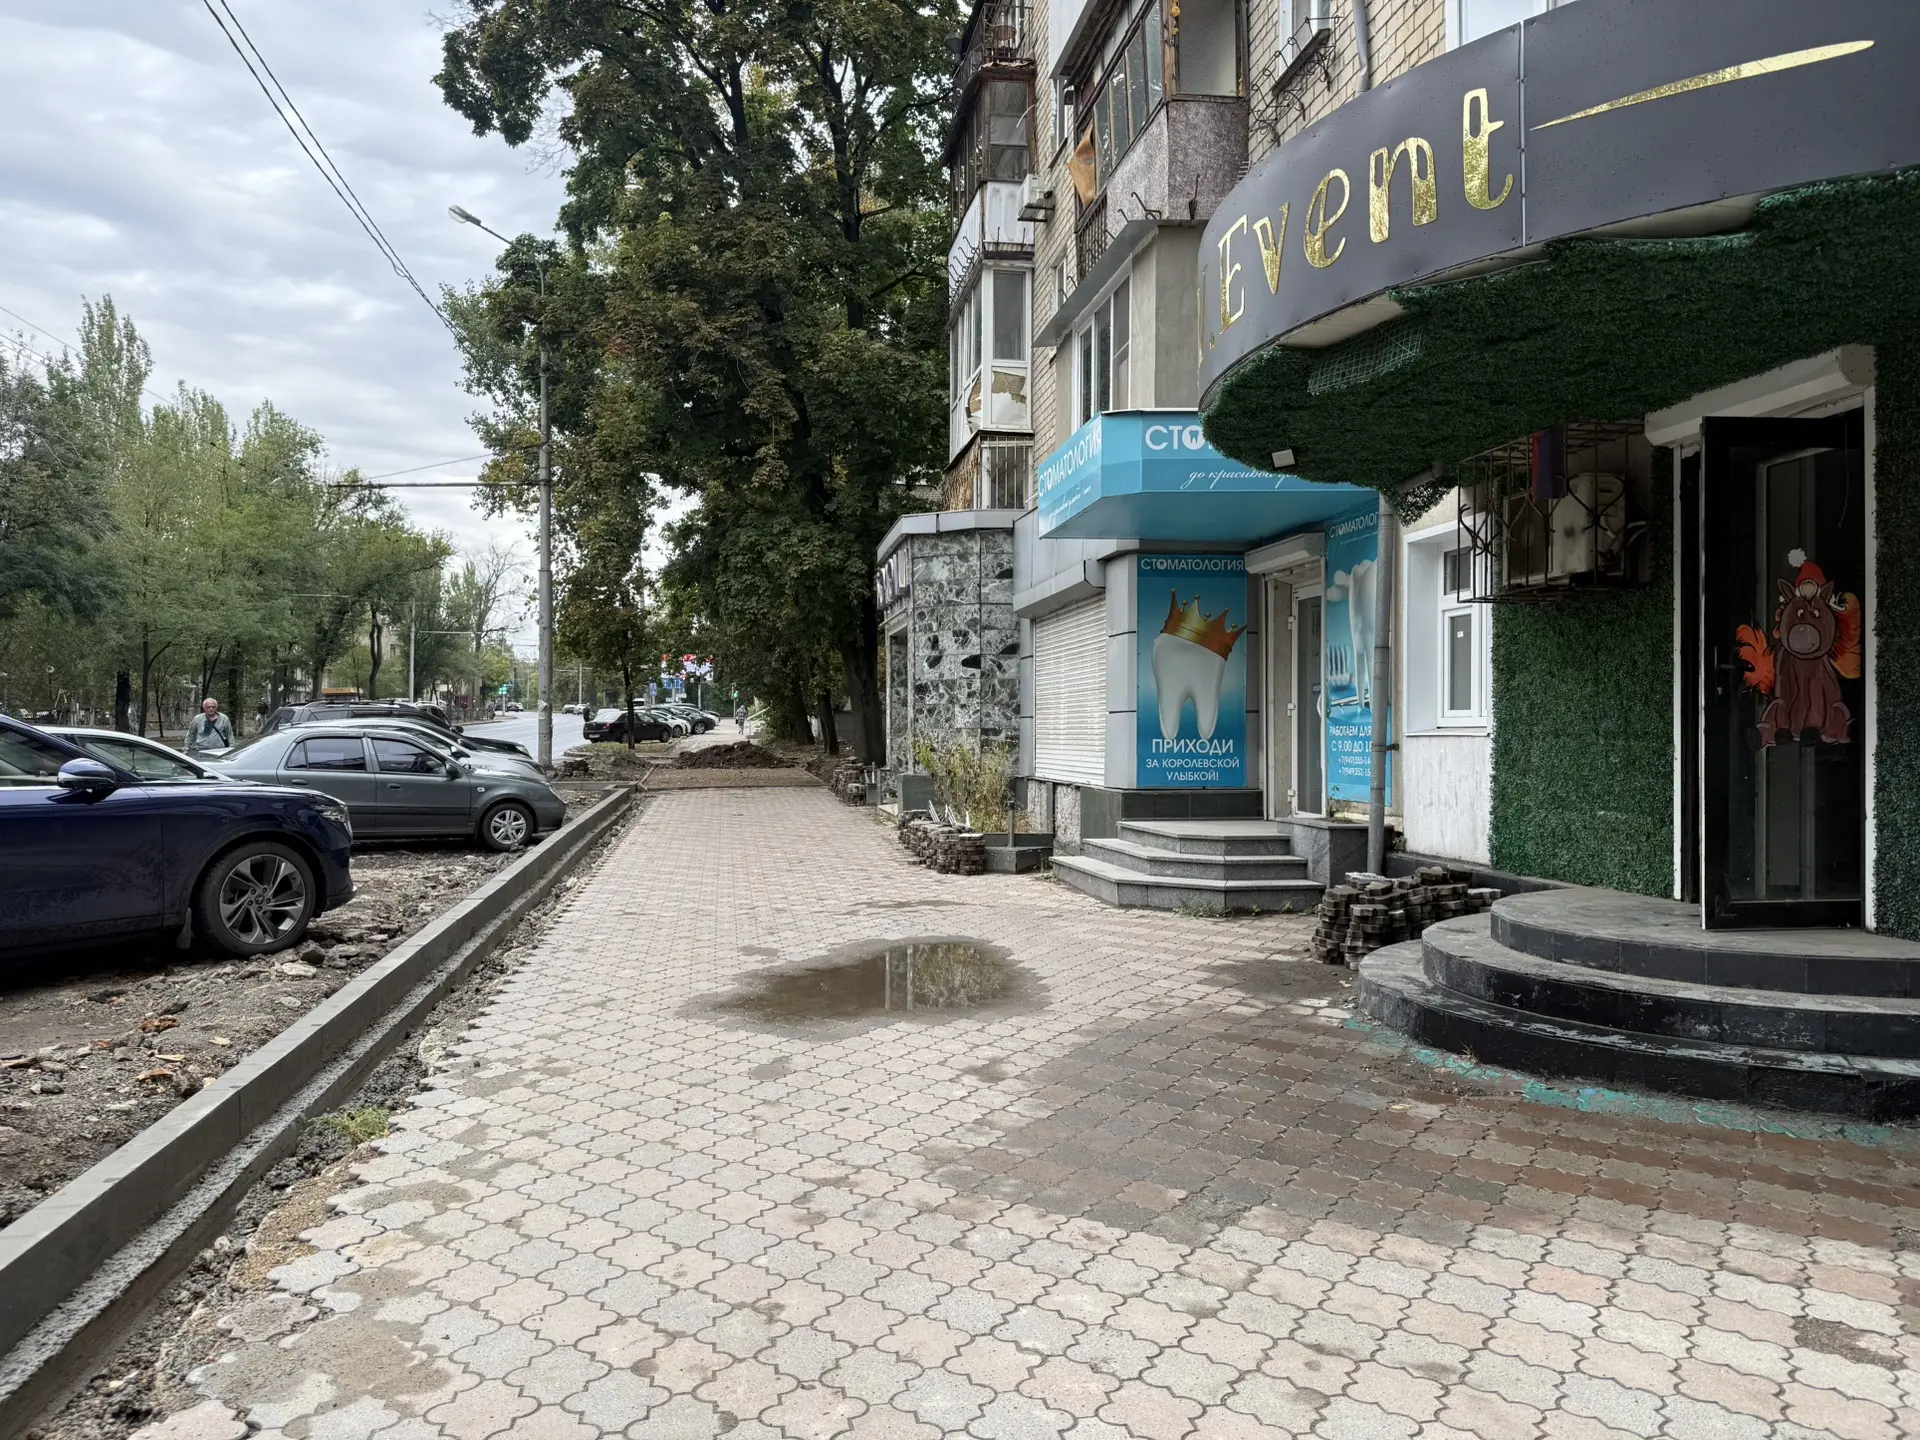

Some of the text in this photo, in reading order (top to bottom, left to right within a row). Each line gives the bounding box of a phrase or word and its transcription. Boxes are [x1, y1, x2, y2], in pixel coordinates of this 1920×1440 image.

[1218, 87, 1514, 335] Event
[1038, 428, 1102, 497] СТОМАТОЛОГИЯ
[1180, 470, 1205, 490] до
[1140, 558, 1244, 571] СТОМАТОЛОГИЯ
[1330, 726, 1358, 736] РАБОТАЕМ
[1152, 738, 1234, 756] ПРИХОДИ
[1353, 740, 1364, 754] ДО
[1146, 757, 1240, 768] ЗА КОРОЛЕВСКОЙ
[1166, 769, 1219, 781] УЛЫБКОЙ!
